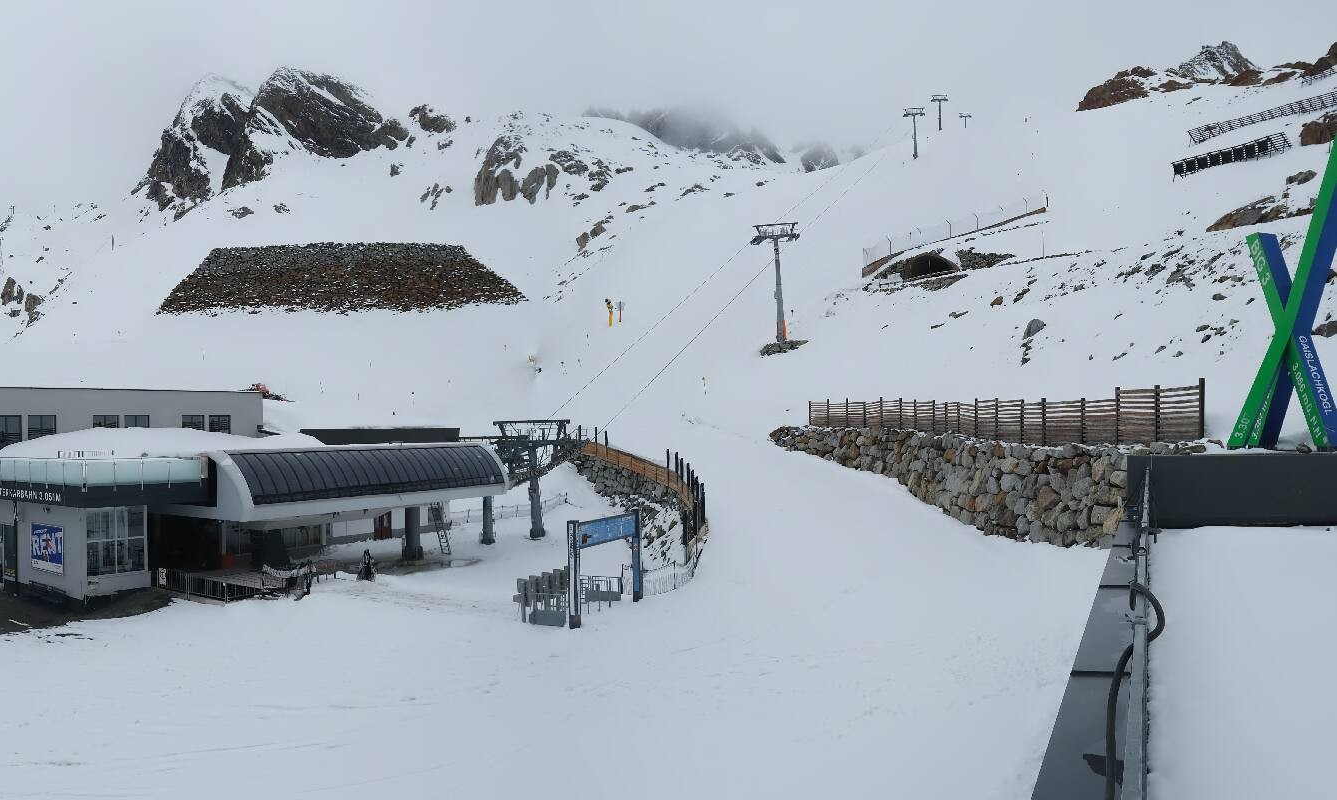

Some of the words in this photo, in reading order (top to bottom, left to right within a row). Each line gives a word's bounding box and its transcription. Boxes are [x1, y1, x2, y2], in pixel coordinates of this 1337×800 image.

[1251, 239, 1266, 272] BIG
[1262, 272, 1271, 286] 3
[1299, 335, 1332, 416] GAISLACHKOGL
[32, 532, 62, 556] RENT
